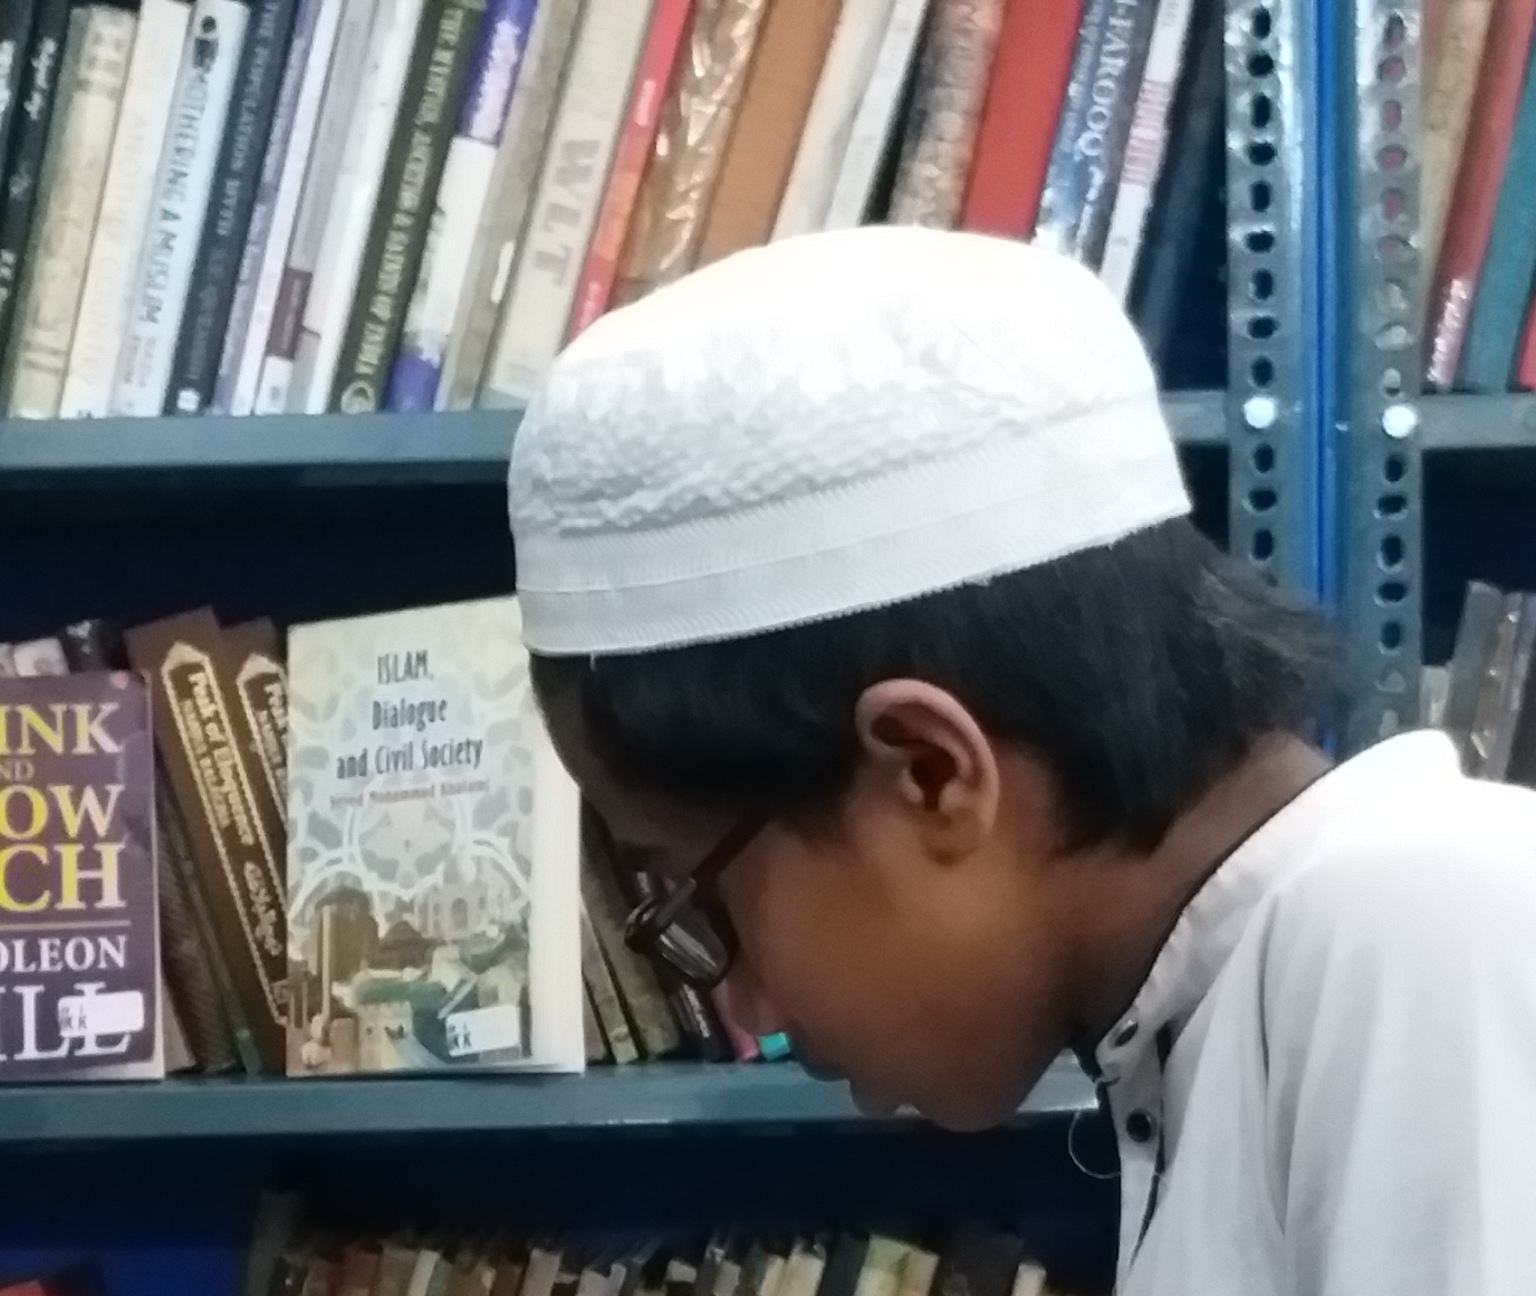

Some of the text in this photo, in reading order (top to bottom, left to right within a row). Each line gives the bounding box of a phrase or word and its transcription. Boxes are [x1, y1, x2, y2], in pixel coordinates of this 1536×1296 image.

[372, 698, 448, 732] Dialogue
[337, 737, 483, 779] and Civil Society
